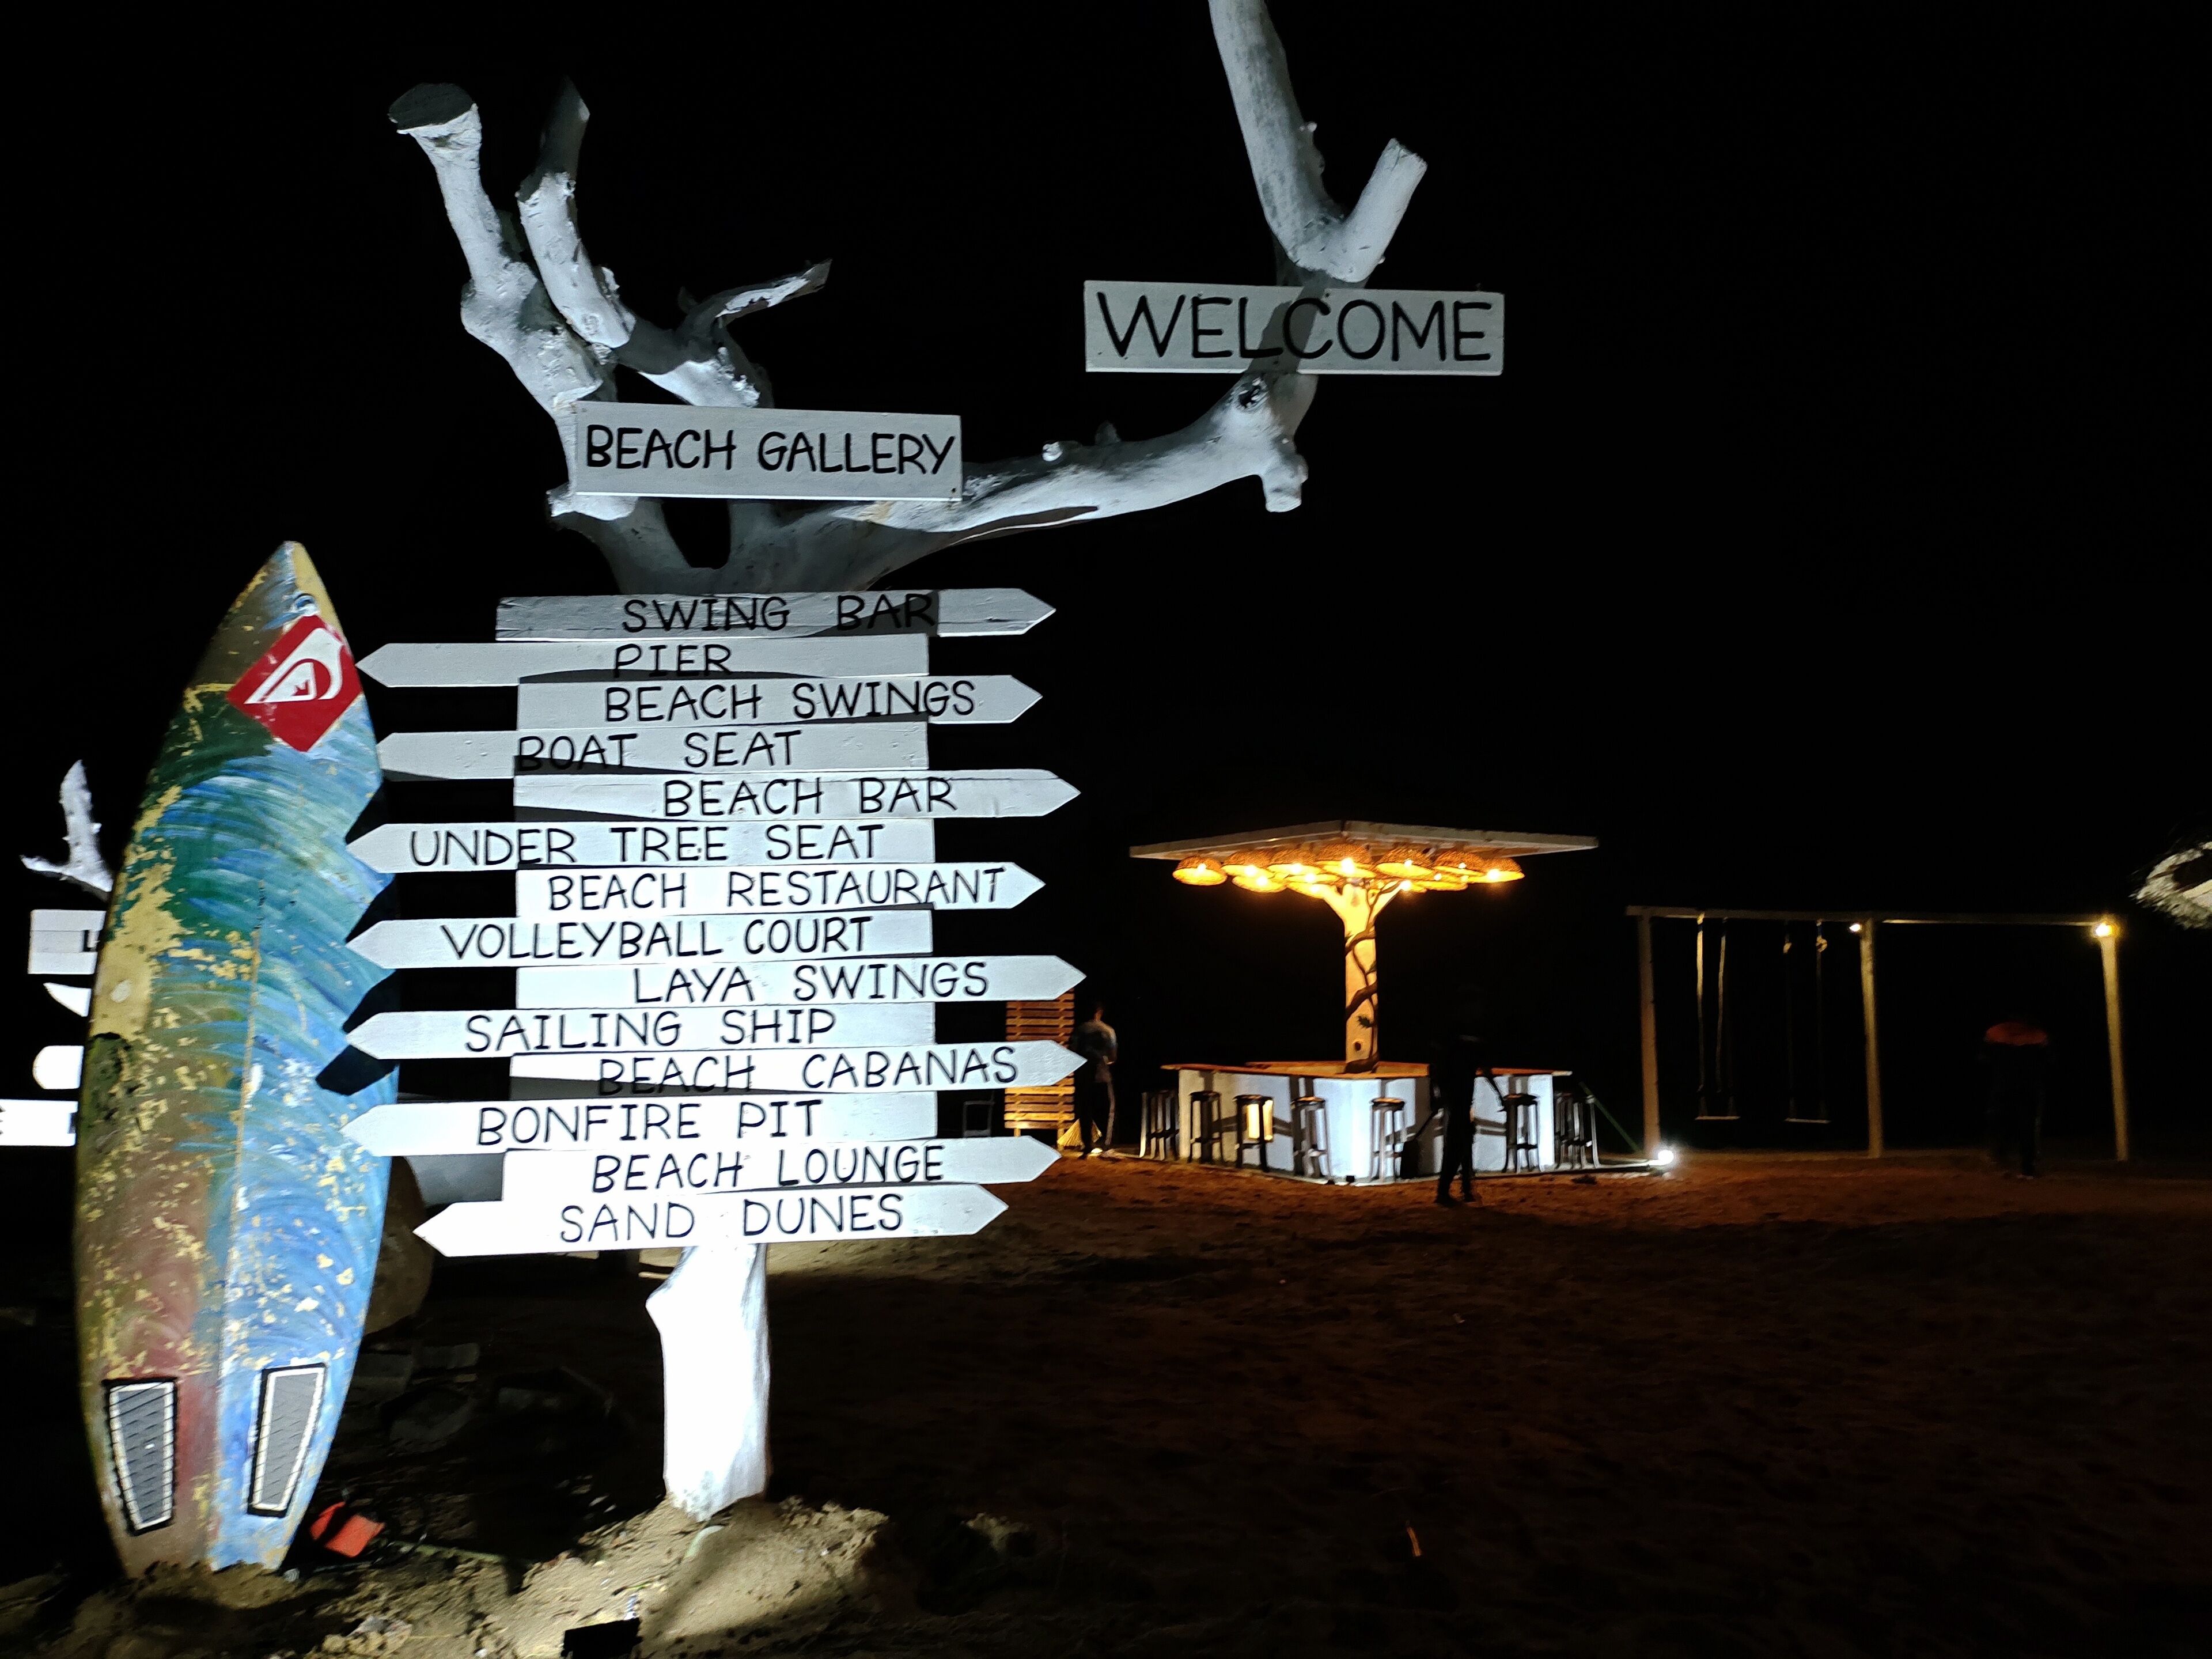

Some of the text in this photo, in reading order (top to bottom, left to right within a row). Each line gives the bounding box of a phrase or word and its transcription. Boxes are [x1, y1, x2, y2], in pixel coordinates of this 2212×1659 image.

[1096, 291, 1492, 361] WELCOME
[586, 424, 956, 475] BEACH GALLERY
[621, 591, 936, 632] SWING BAR
[613, 644, 733, 678] PIER
[605, 679, 976, 722] BEACH SWINGS
[518, 729, 802, 770] BOAT SEAT
[662, 777, 959, 818] BEACH BAR
[409, 824, 885, 866] UNDER TREE SEAT
[547, 868, 1006, 911] BEACH RESTAURANT
[439, 916, 873, 961] VOLLEYBALL COURT
[634, 960, 991, 1005] LAYA SWINGS
[464, 1007, 838, 1053] SAILING SHIP
[599, 1045, 1018, 1096] BEACH CABANAS
[478, 1099, 824, 1147] BONFIRE PIT
[591, 1144, 946, 1194] BEACH LOUNGE
[559, 1191, 906, 1244] SAND DUNES
